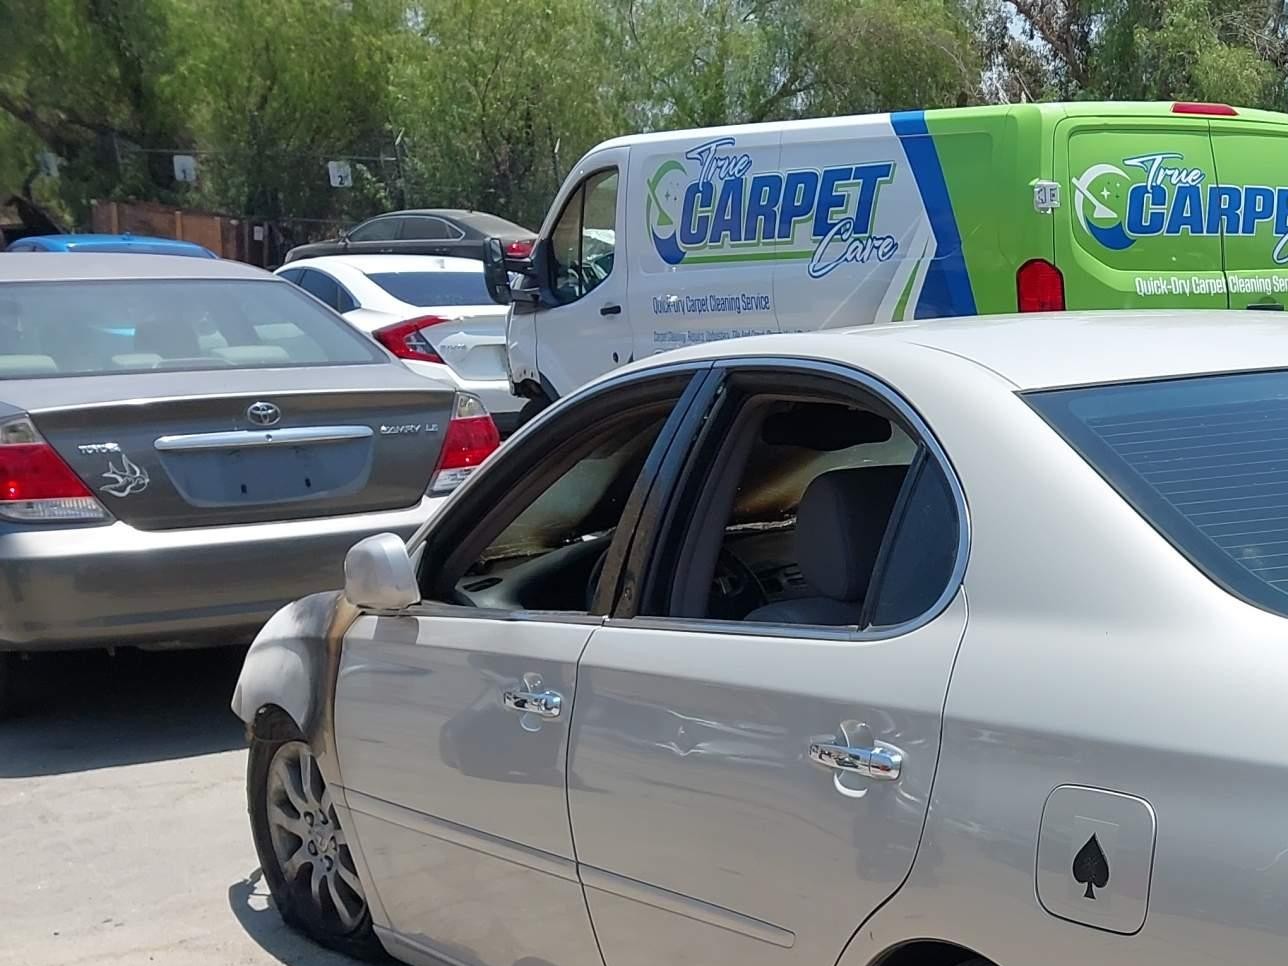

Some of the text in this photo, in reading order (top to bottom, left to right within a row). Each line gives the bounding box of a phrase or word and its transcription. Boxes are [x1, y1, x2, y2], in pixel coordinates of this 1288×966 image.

[686, 137, 752, 191] True
[1122, 153, 1206, 193] True
[679, 160, 897, 250] CARPET
[808, 216, 899, 278] Care
[686, 296, 709, 315] Carpet
[709, 294, 741, 314] Cleaning
[741, 294, 770, 311] Service
[1135, 277, 1190, 296] Quick-Dry
[1191, 277, 1227, 295] Carpet
[1228, 275, 1271, 294] Cleaning
